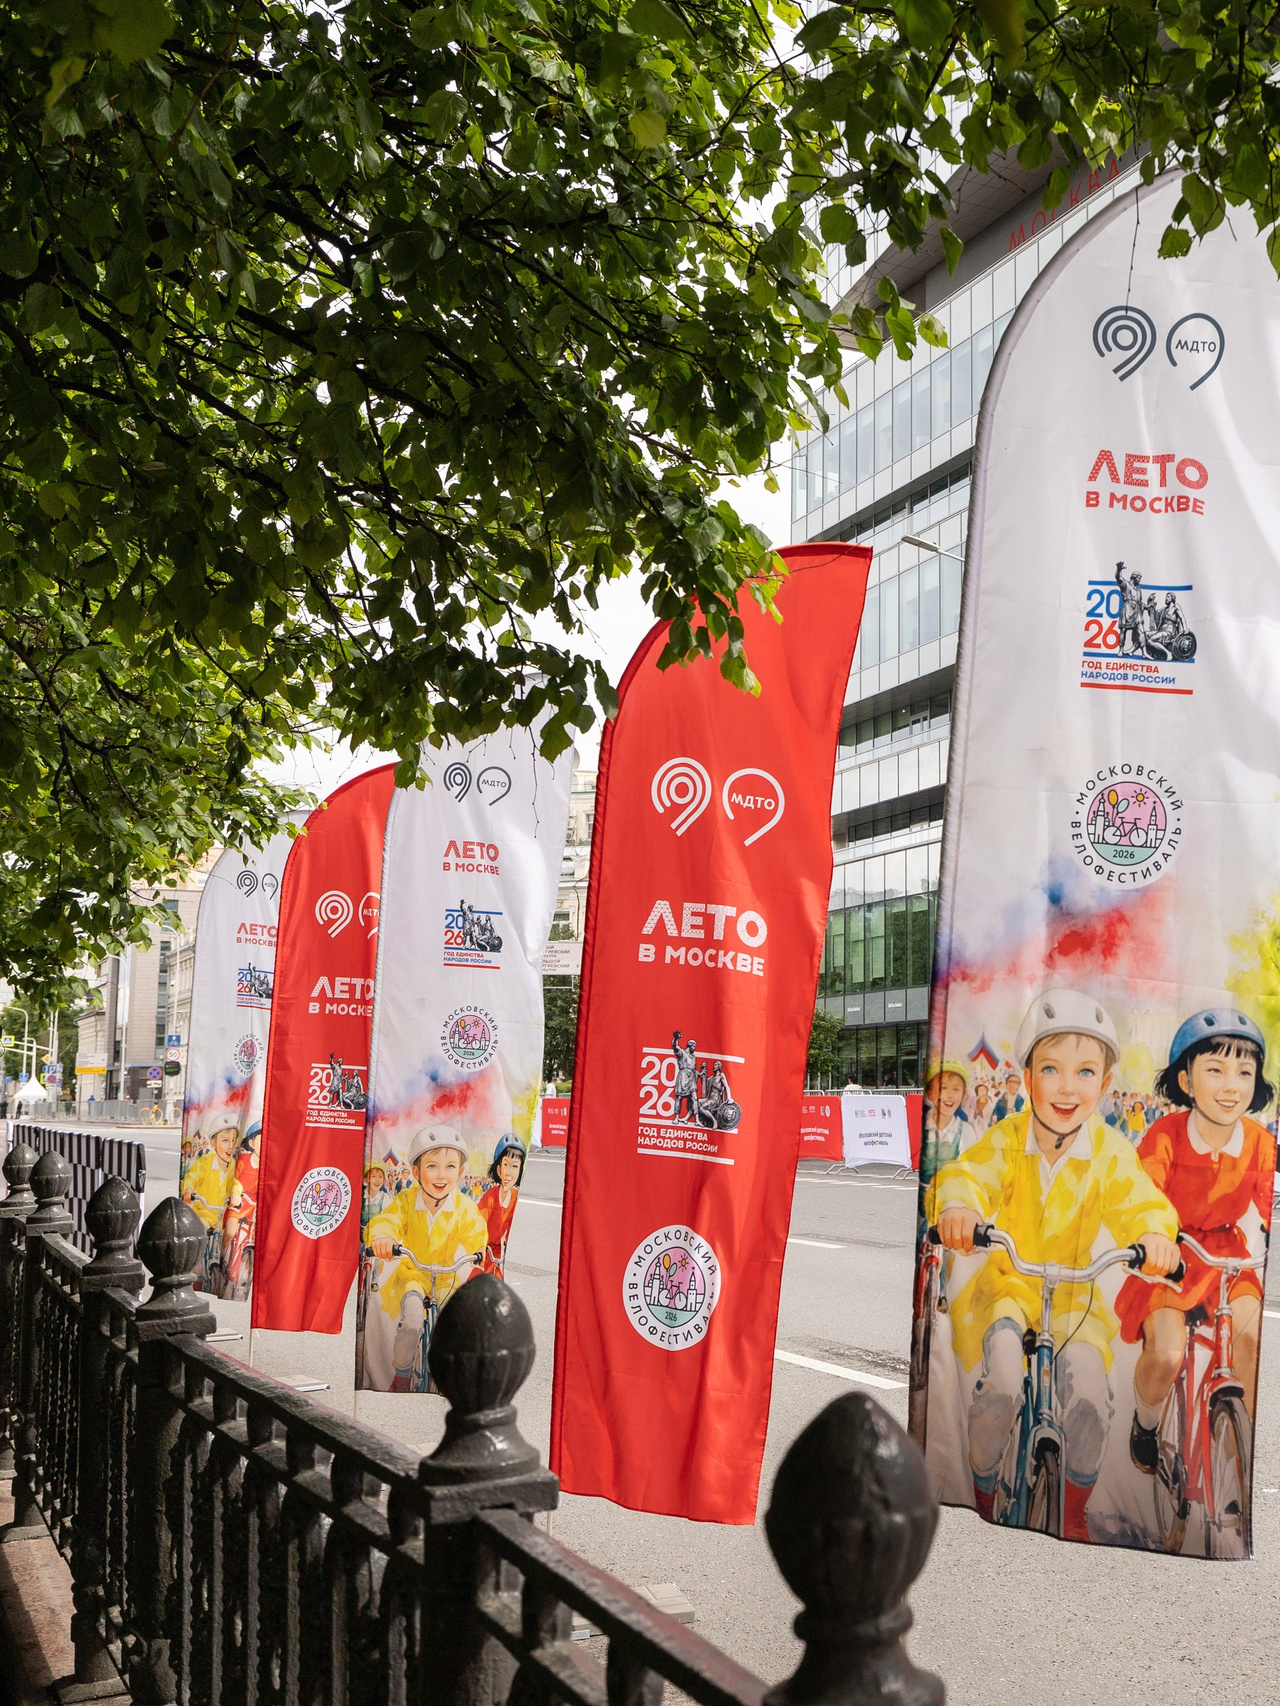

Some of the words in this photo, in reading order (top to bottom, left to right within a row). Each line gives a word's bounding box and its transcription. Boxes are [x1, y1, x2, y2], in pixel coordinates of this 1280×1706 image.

[1175, 339, 1217, 354] МДТО
[1087, 449, 1209, 490] ЛЕТО
[1085, 491, 1101, 508] В
[1108, 492, 1206, 516] МОСКВЕ
[1086, 589, 1124, 619] 20
[1083, 619, 1120, 650] 26
[1081, 660, 1102, 671] ГОД
[1105, 662, 1160, 674] ЕДИНСТВА
[1080, 671, 1129, 681] НАРОДОВ
[1132, 674, 1176, 685] РОССИИ
[481, 779, 507, 789] МДТО
[1076, 763, 1184, 811] МОСКОВСКИЙ
[730, 792, 776, 811] МДТО
[443, 840, 500, 862] ЛЕТО
[1071, 821, 1182, 884] ВЕЛОФЕСТИВАЛЬ
[1112, 849, 1136, 860] 2026
[442, 862, 451, 872] В
[455, 862, 500, 876] МОСКВЕ
[237, 922, 278, 939] ЛЕТО
[444, 913, 465, 930] 20
[641, 900, 768, 948] ЛЕТО
[444, 929, 464, 946] 26
[638, 943, 656, 963] В
[664, 945, 766, 977] МОСКВЕ
[237, 972, 252, 983] 20
[237, 982, 251, 993] 26
[310, 976, 375, 1001] ЛЕТО
[308, 1002, 320, 1014] В
[443, 1005, 498, 1031] МОСКОВСКИЙ
[440, 1036, 498, 1069] ВЕЛОФЕСТИВАЛЬ
[310, 1068, 333, 1087] 20
[640, 1055, 681, 1088] 20
[308, 1086, 330, 1105] 26
[639, 1085, 676, 1117] 26
[319, 1110, 348, 1118] ЕДИНСТВА
[335, 1117, 356, 1125] РОССИИ
[638, 1126, 657, 1137] ГОД
[660, 1128, 708, 1142] ЕДИНСТВА
[637, 1136, 684, 1149] НАРОДОВ
[686, 1141, 718, 1153] РОССИИ
[298, 1169, 350, 1197] МОСКОВСКИЙ
[634, 1229, 717, 1276] МОСКОВСКИЙ
